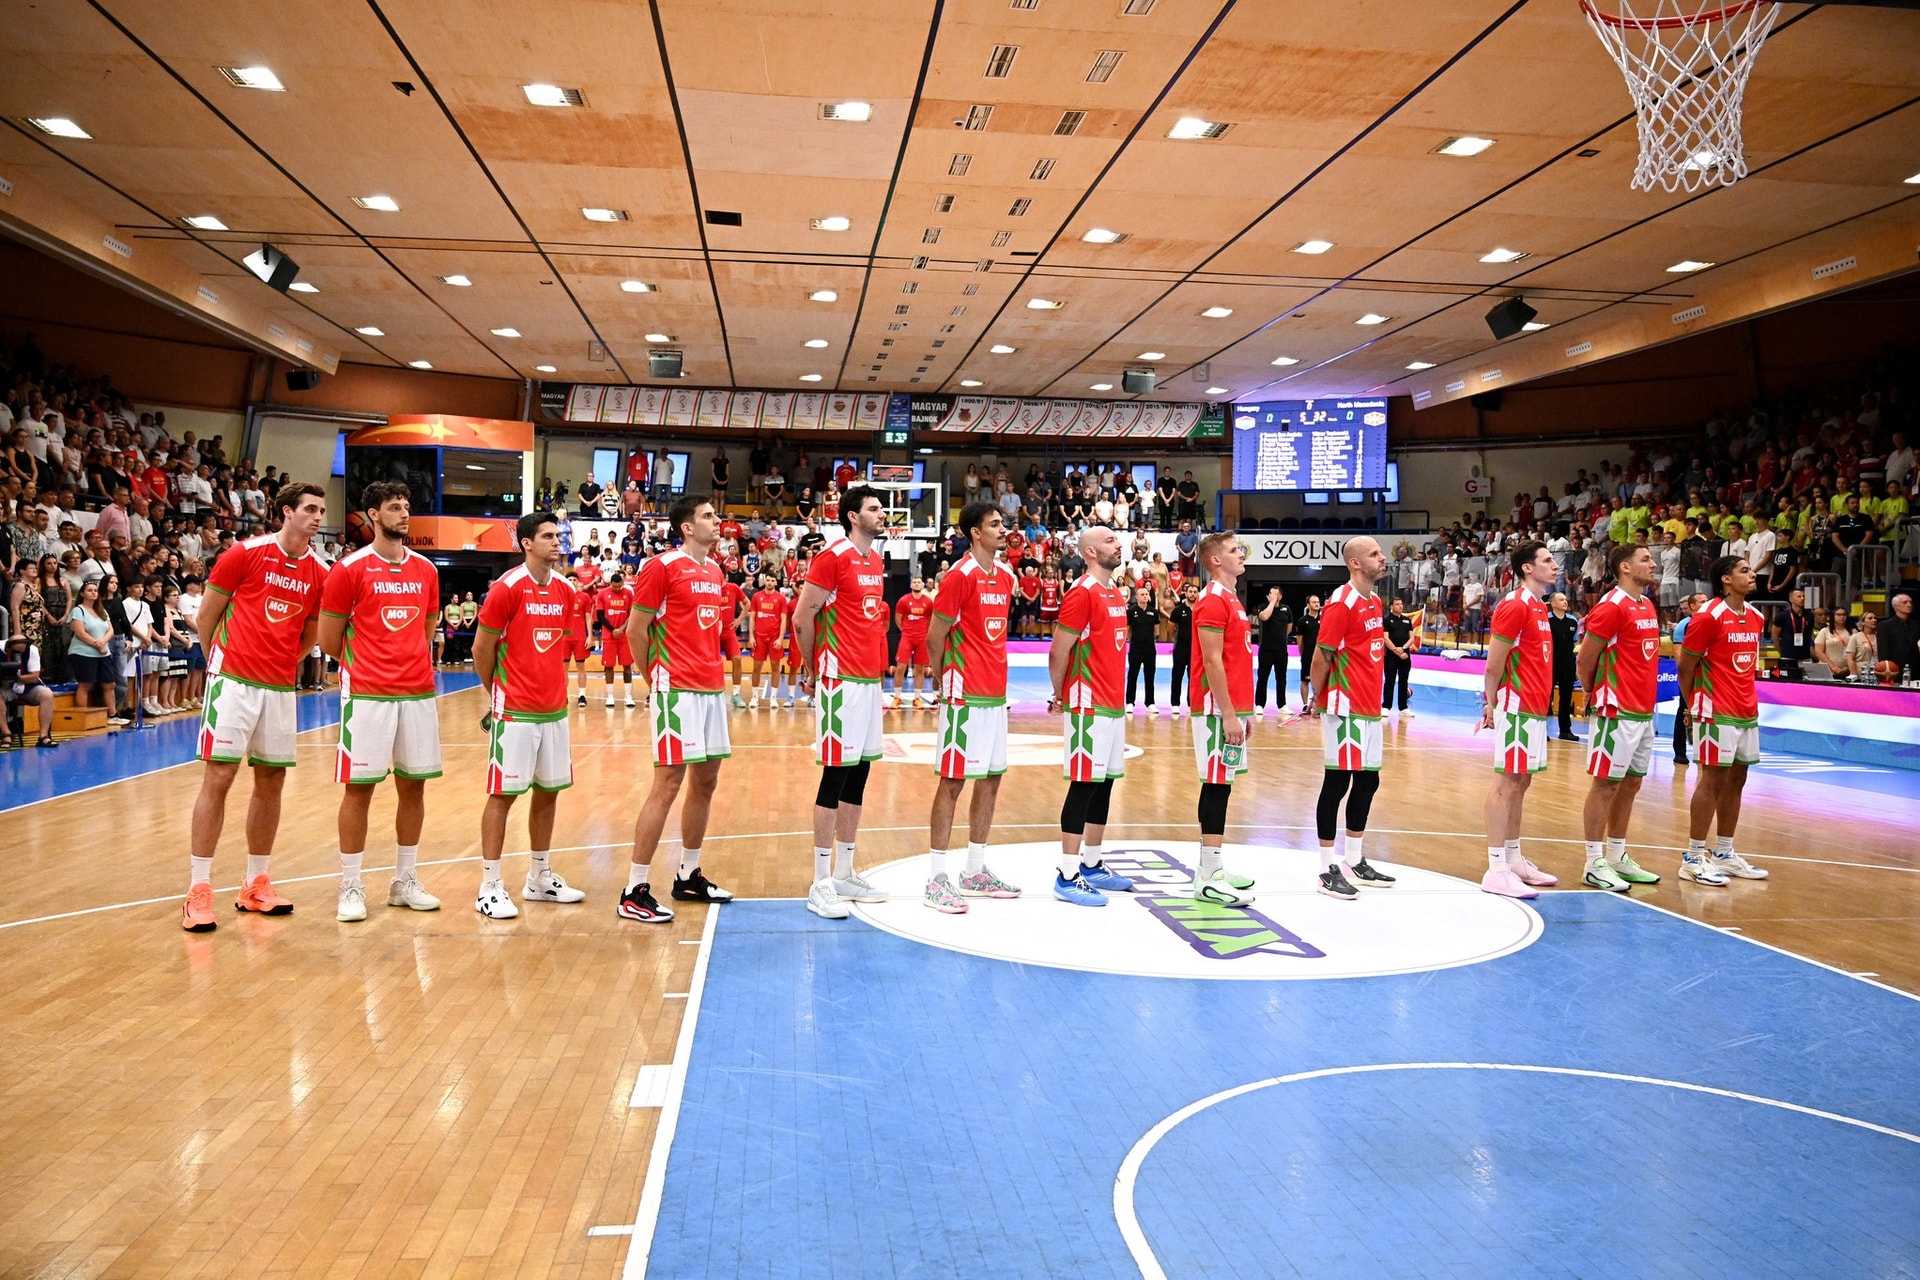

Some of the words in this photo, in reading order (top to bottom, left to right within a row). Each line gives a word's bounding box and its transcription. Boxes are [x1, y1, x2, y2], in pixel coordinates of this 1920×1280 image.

[911, 402, 948, 412] MAGYAR
[911, 415, 938, 423] BAJNOK
[1266, 413, 1274, 423] 0
[1346, 410, 1354, 421] 0
[1465, 480, 1478, 493] G
[1263, 540, 1347, 560] SZOLN
[265, 571, 311, 595] HUNGARY
[373, 581, 422, 594] HUNGARY
[268, 600, 289, 614] MOL
[610, 599, 625, 607] MKD
[386, 609, 409, 620] MOL
[525, 602, 563, 616] HUNGARY
[700, 608, 716, 618] MOL
[987, 620, 1003, 630] MOL
[536, 631, 552, 641] MOL
[1728, 632, 1759, 643] HUNGARY
[1737, 654, 1752, 663] MOL
